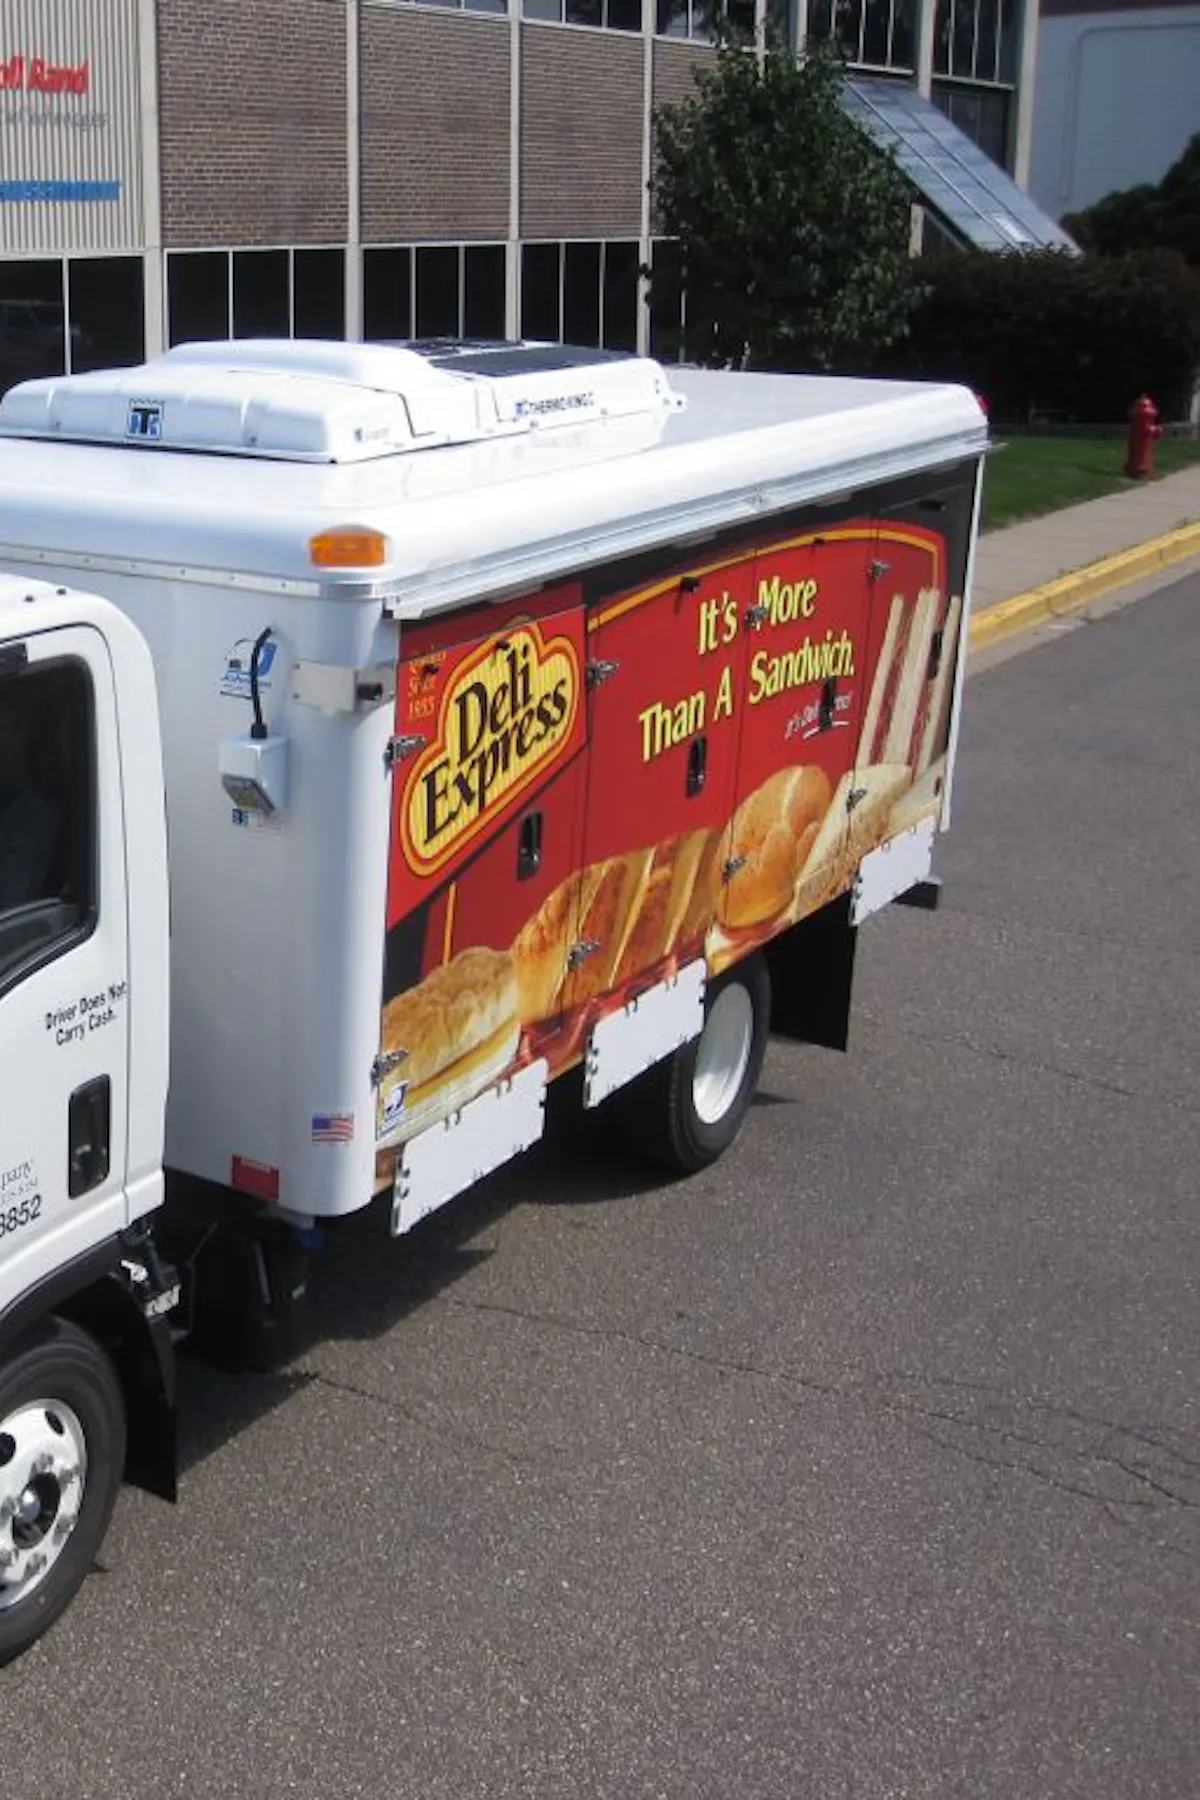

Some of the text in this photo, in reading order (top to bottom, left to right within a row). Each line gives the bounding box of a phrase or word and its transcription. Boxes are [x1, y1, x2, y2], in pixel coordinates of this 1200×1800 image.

[27, 57, 90, 95] Rand
[697, 576, 818, 656] It's More
[455, 644, 532, 767] Deli
[639, 690, 706, 762] Than
[712, 666, 733, 722] A
[749, 629, 855, 705] Sandwich.
[422, 678, 568, 847] Express
[46, 1005, 78, 1031] Driver
[79, 992, 106, 1015] Does
[56, 1022, 85, 1046] Carry
